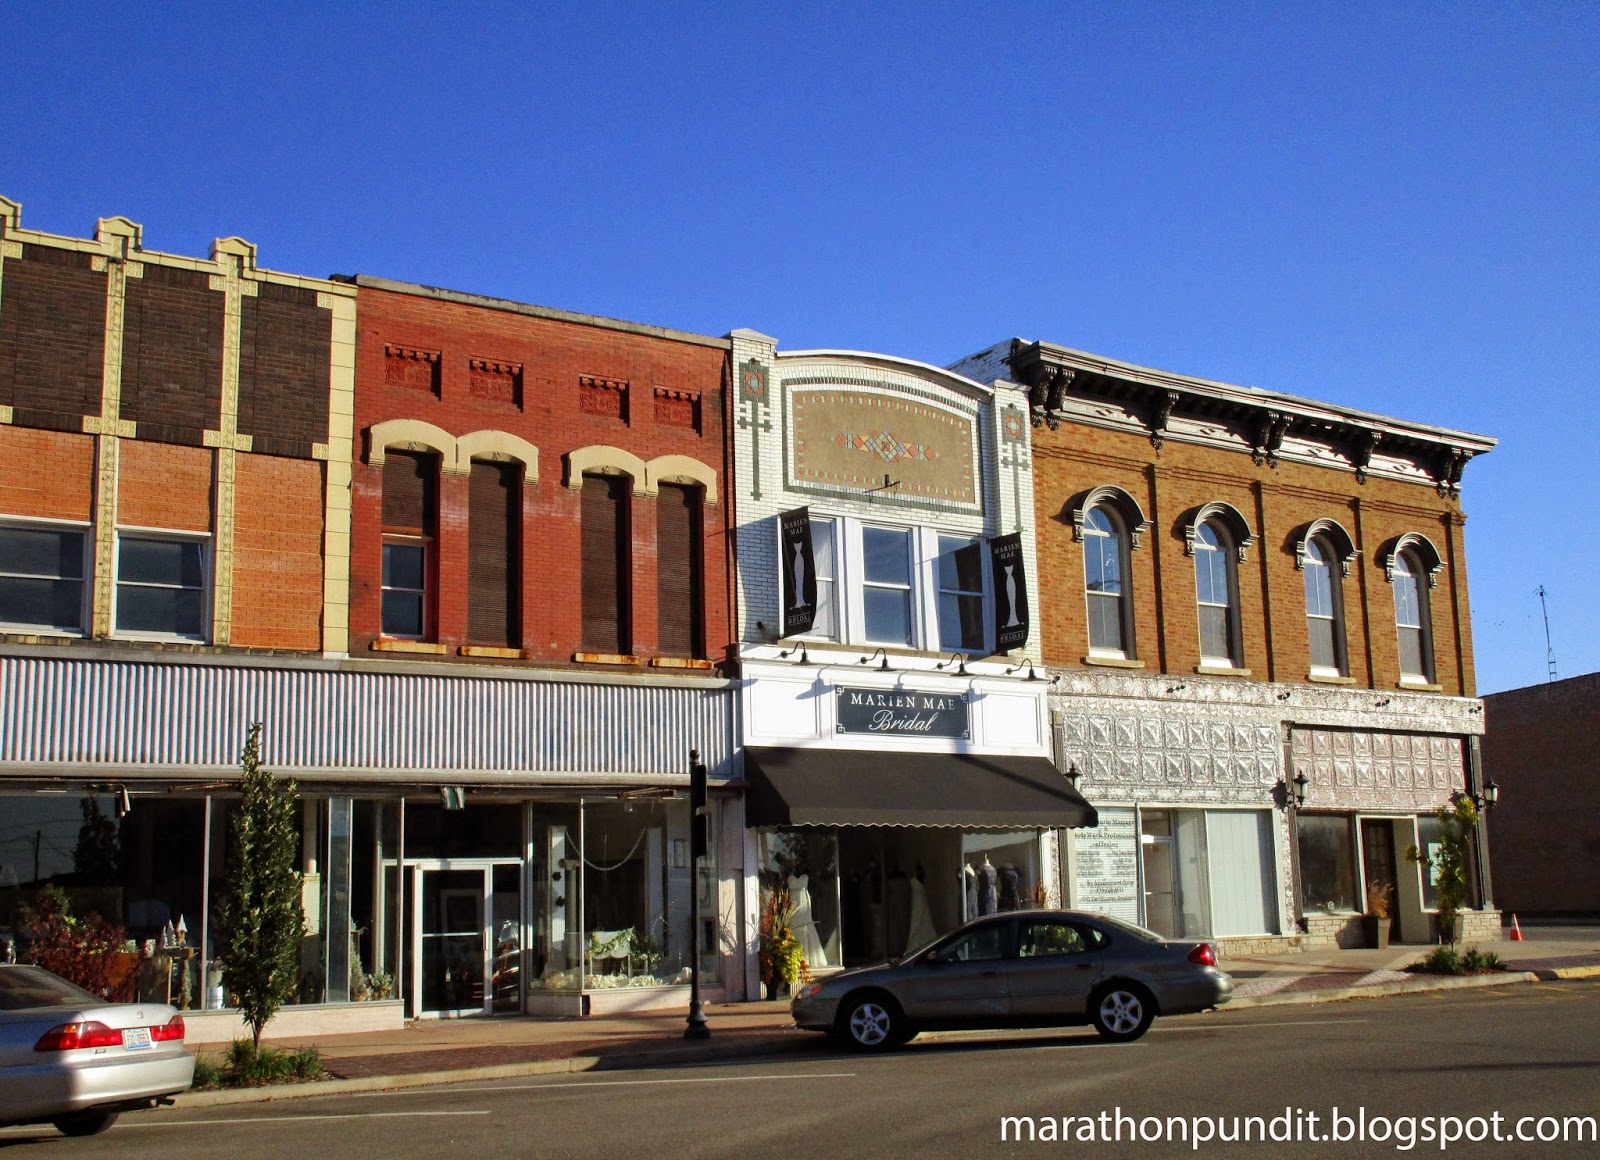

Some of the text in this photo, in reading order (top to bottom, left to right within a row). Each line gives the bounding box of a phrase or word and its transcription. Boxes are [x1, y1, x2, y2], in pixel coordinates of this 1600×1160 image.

[784, 519, 808, 530] MARIEN
[790, 526, 803, 535] MAE
[994, 542, 1020, 554] MARIEN
[1000, 552, 1015, 560] MAE
[788, 614, 811, 625] BRIDAL
[1000, 632, 1025, 642] BRIDAL
[851, 693, 956, 710] MARIEN MAE
[868, 709, 939, 731] Bridal
